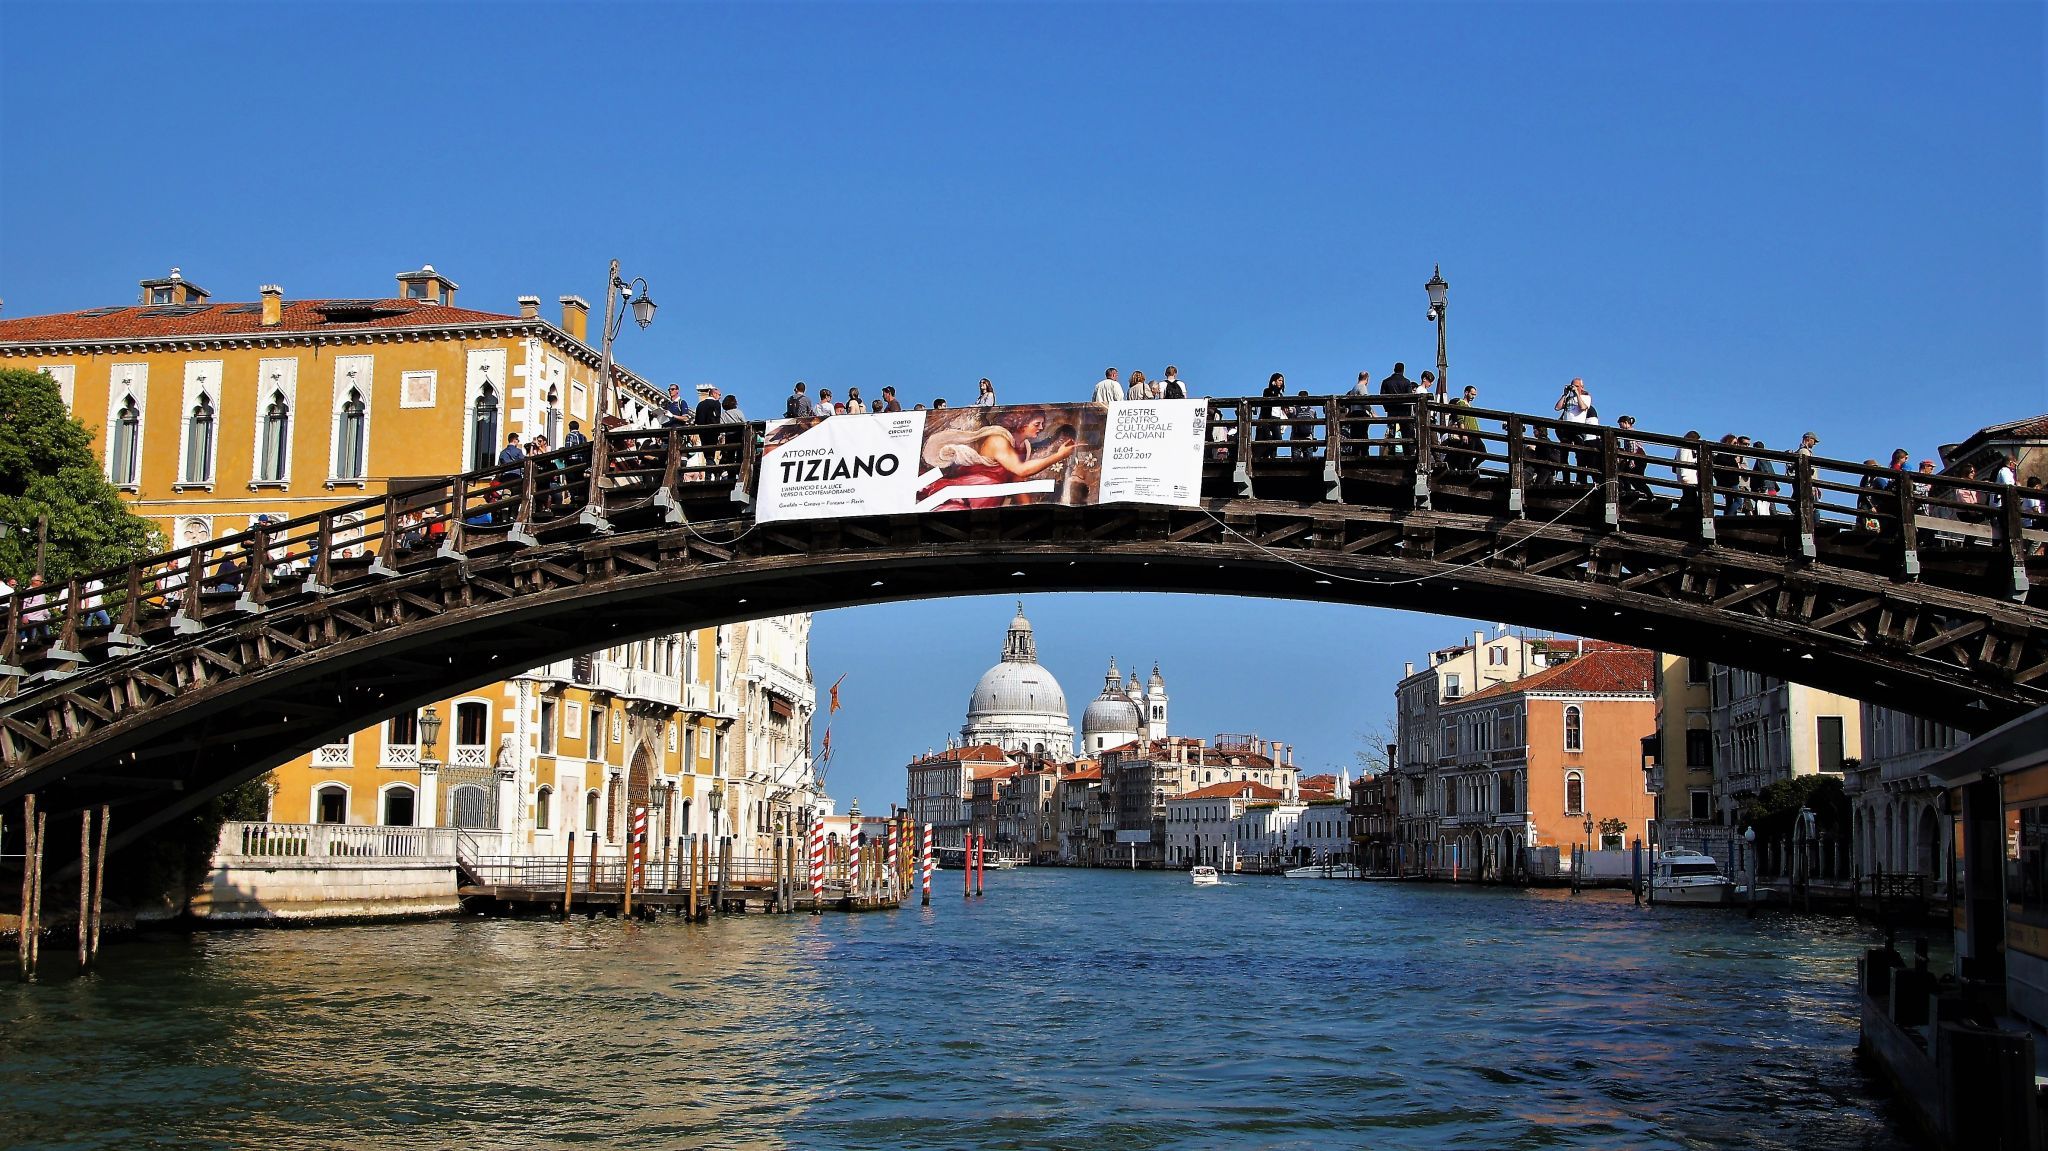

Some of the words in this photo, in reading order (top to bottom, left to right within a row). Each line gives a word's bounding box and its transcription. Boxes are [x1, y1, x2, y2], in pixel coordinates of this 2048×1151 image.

[1118, 408, 1156, 417] MESTRE
[1117, 416, 1159, 424] CENTRO
[1116, 423, 1173, 432] CULTURALE
[1115, 432, 1165, 440] CANDIANI
[782, 449, 825, 459] ATTORNO
[780, 453, 899, 484] TIZIANO
